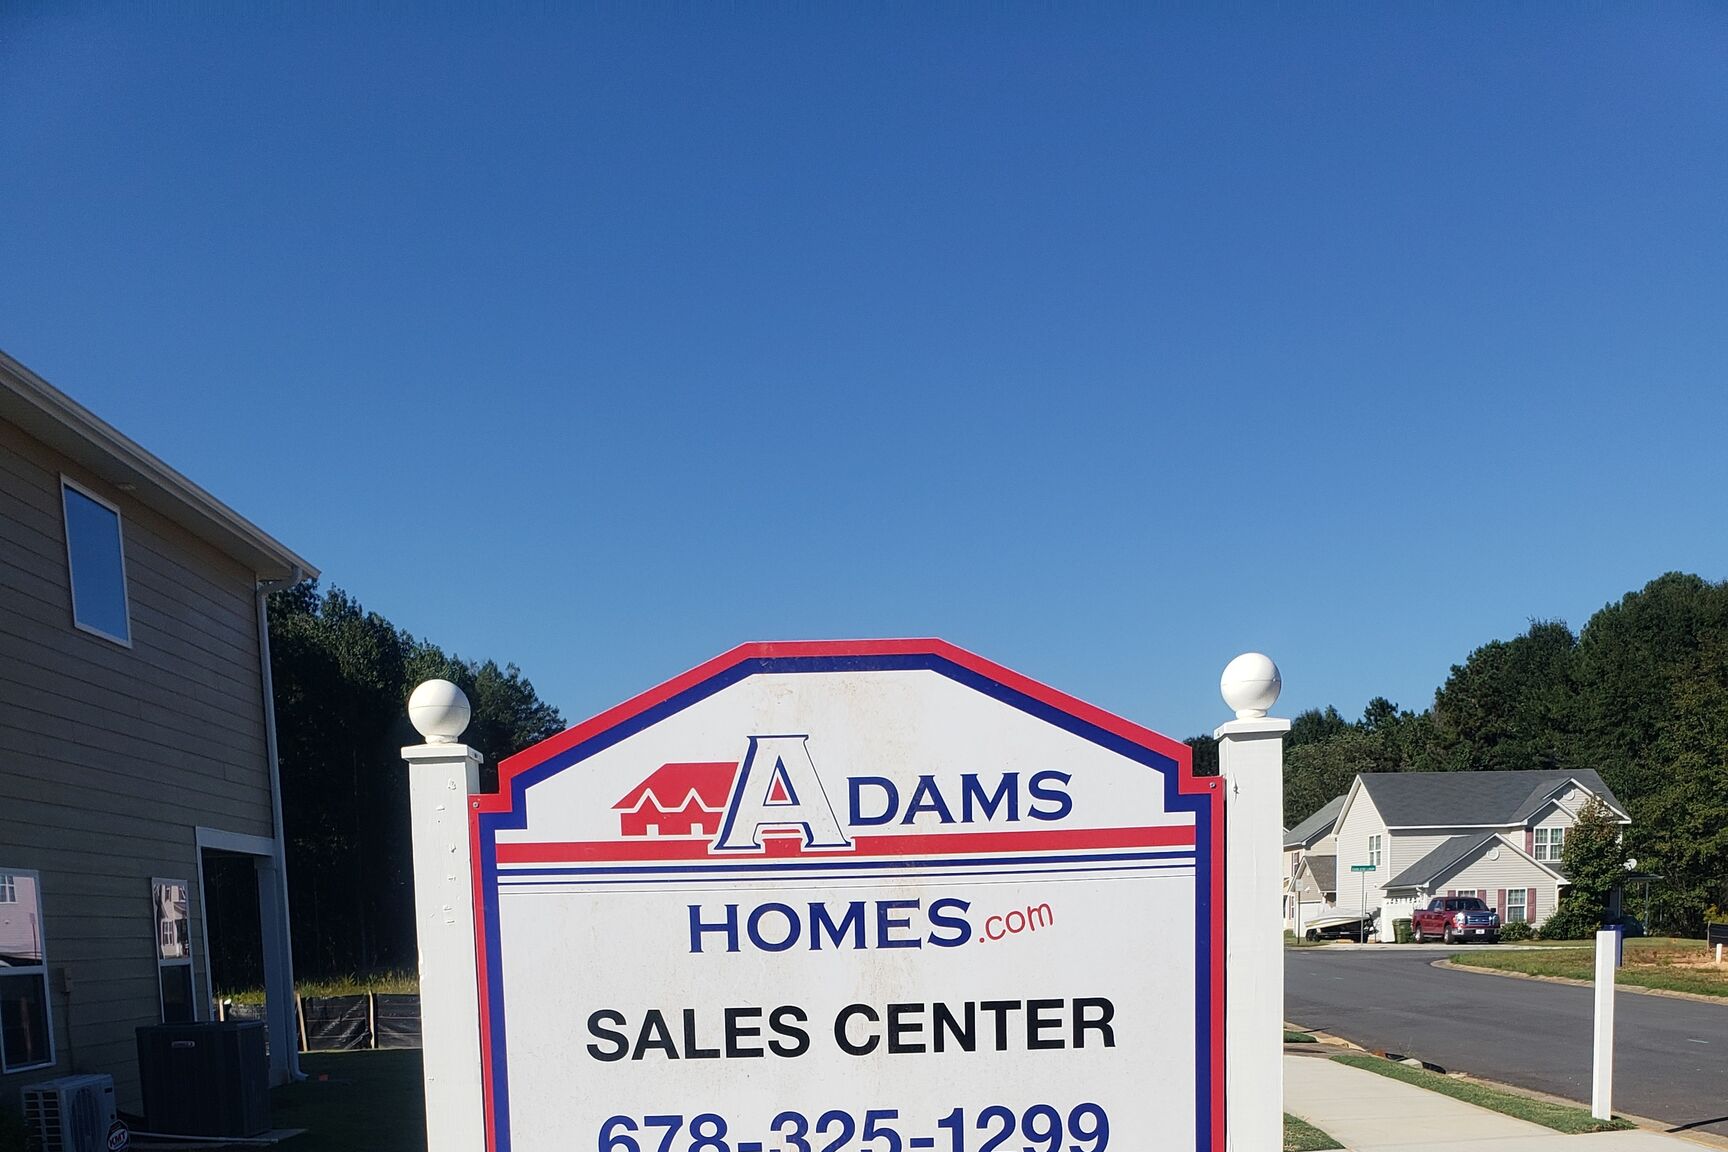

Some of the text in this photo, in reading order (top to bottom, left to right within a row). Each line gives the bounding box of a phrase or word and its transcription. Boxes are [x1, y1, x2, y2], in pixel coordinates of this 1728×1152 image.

[712, 734, 1074, 852] ADAMS
[586, 996, 1116, 1063] SALES CENTER
